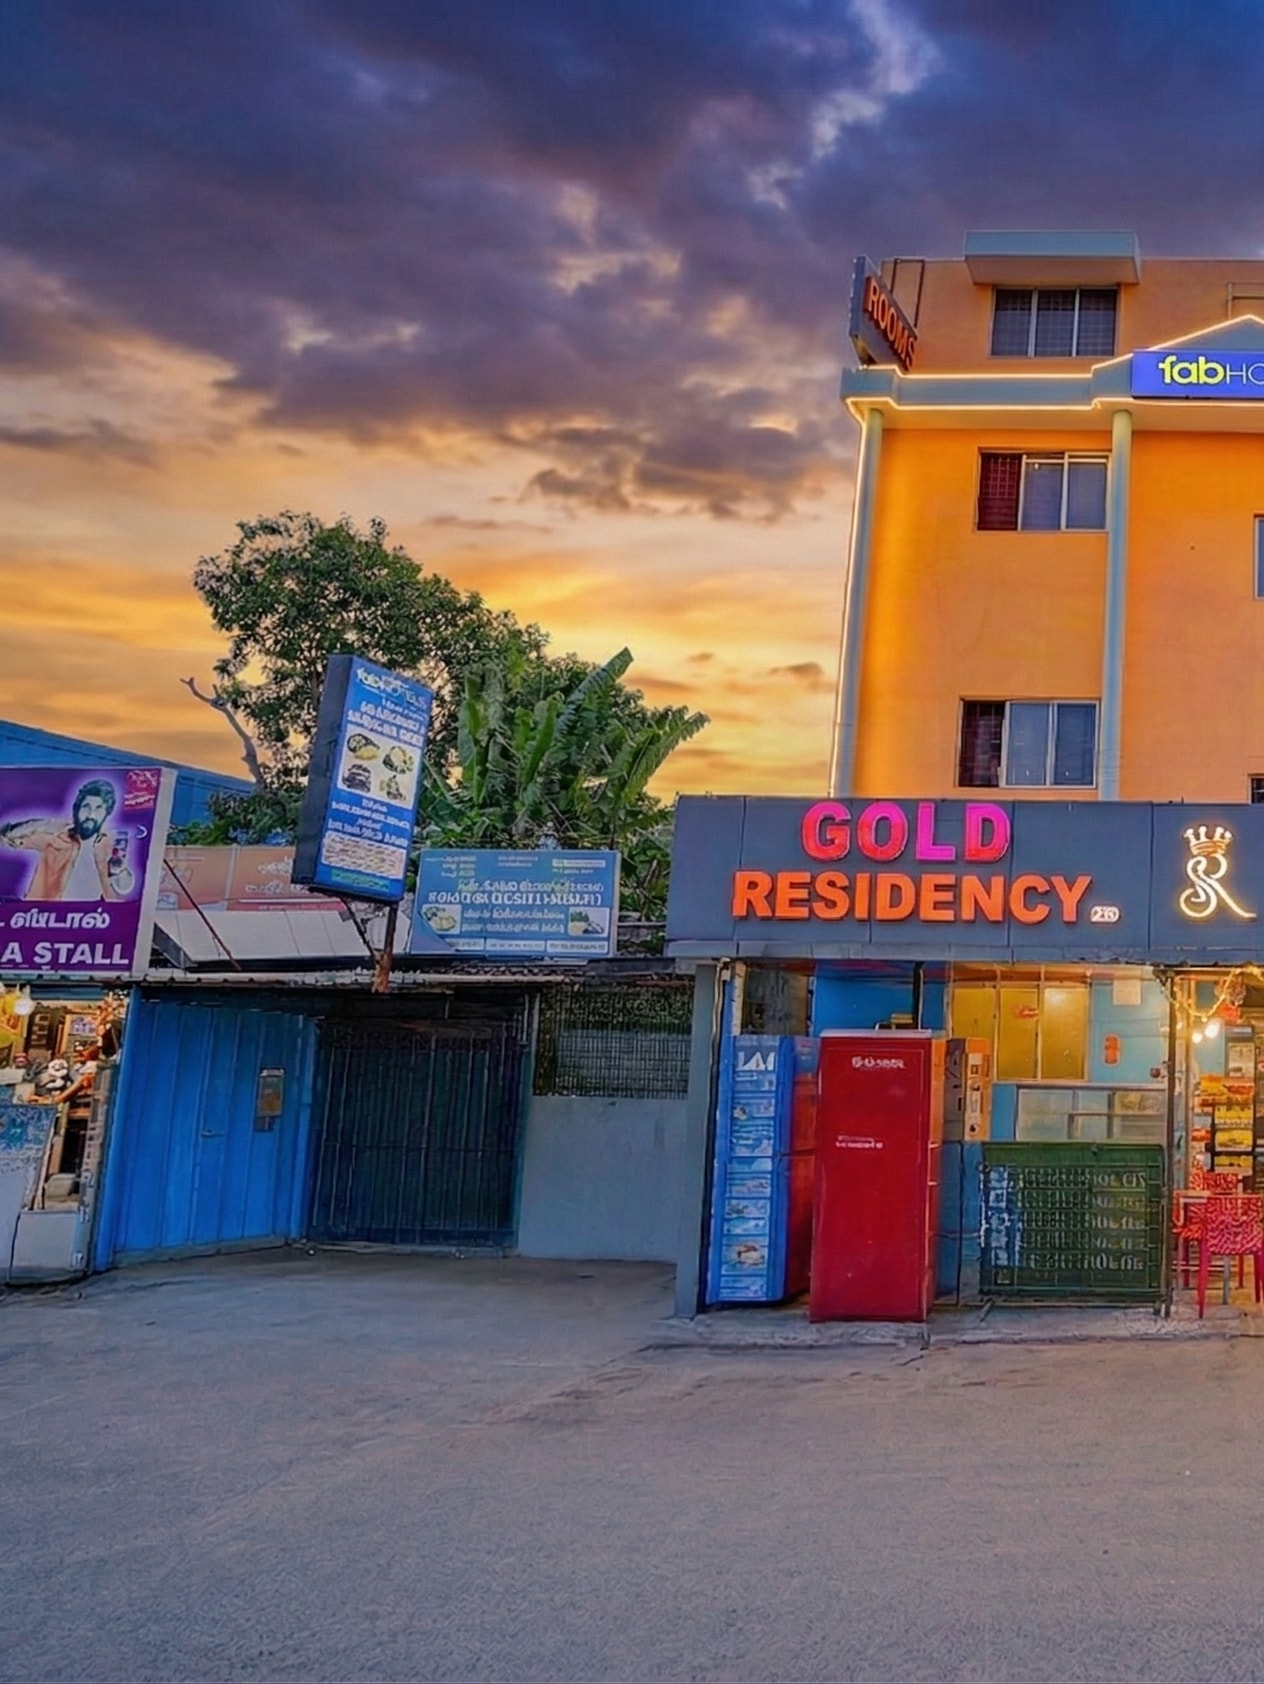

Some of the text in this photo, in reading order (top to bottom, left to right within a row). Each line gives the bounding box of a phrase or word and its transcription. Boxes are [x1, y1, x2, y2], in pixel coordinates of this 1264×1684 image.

[868, 277, 915, 371] ROOMS
[801, 801, 1011, 862] GOLD
[732, 871, 1092, 923] RESIDENCY
[33, 942, 129, 965] STALL
